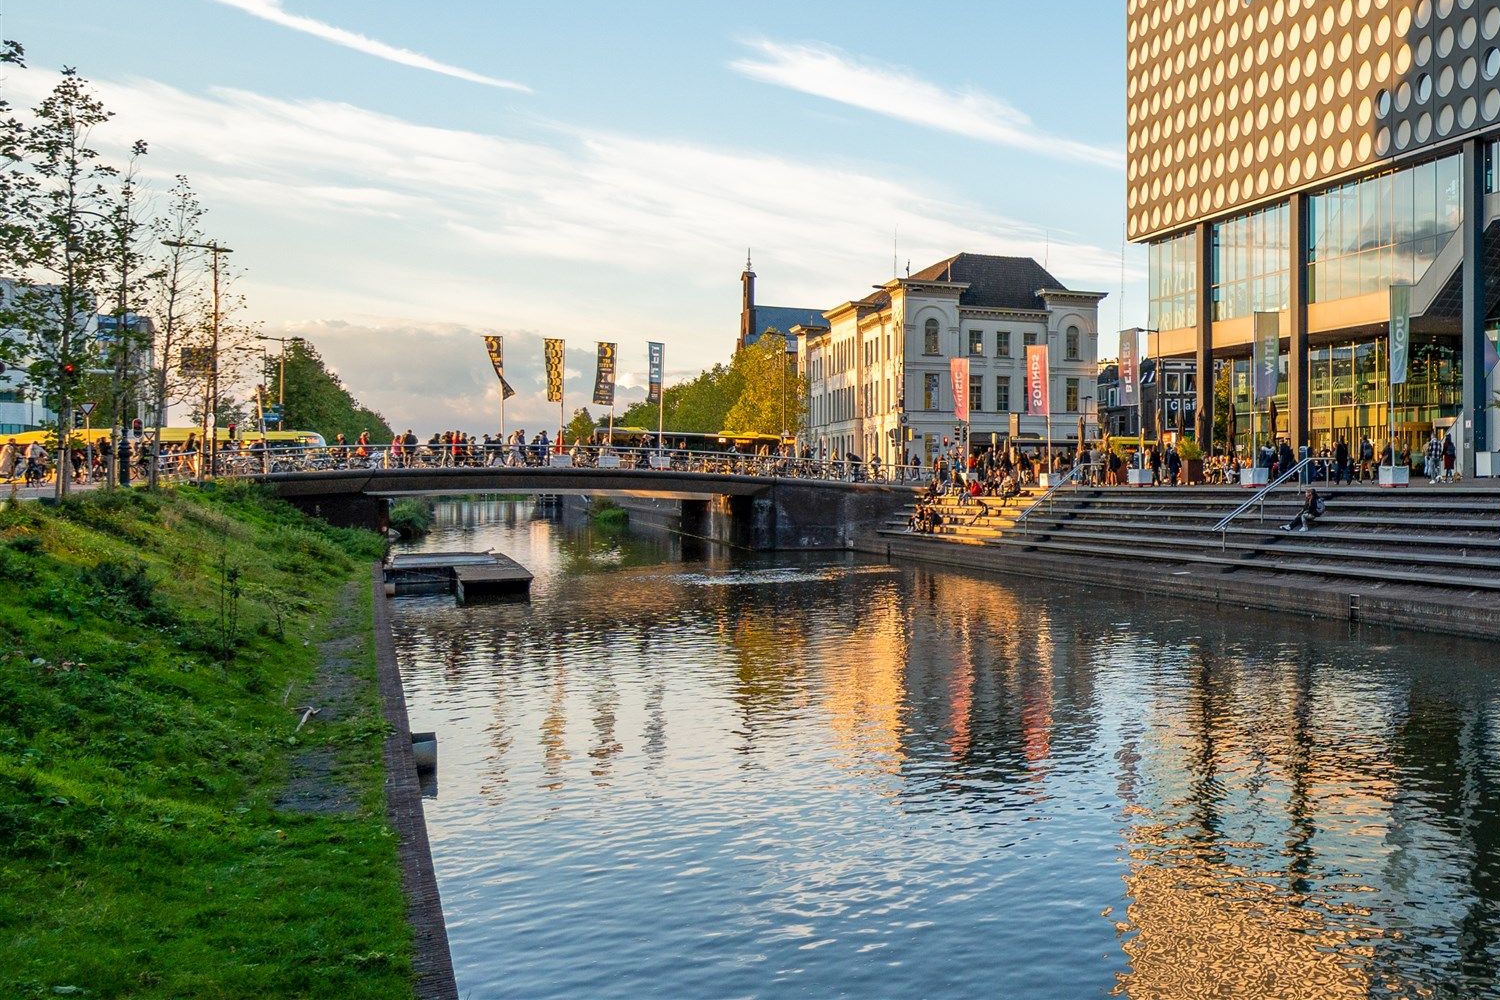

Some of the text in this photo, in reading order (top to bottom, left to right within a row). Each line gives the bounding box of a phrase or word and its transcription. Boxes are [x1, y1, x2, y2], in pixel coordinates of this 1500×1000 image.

[1394, 315, 1405, 355] YOU
[1264, 335, 1274, 376] WITH
[1170, 401, 1196, 410] Caf
